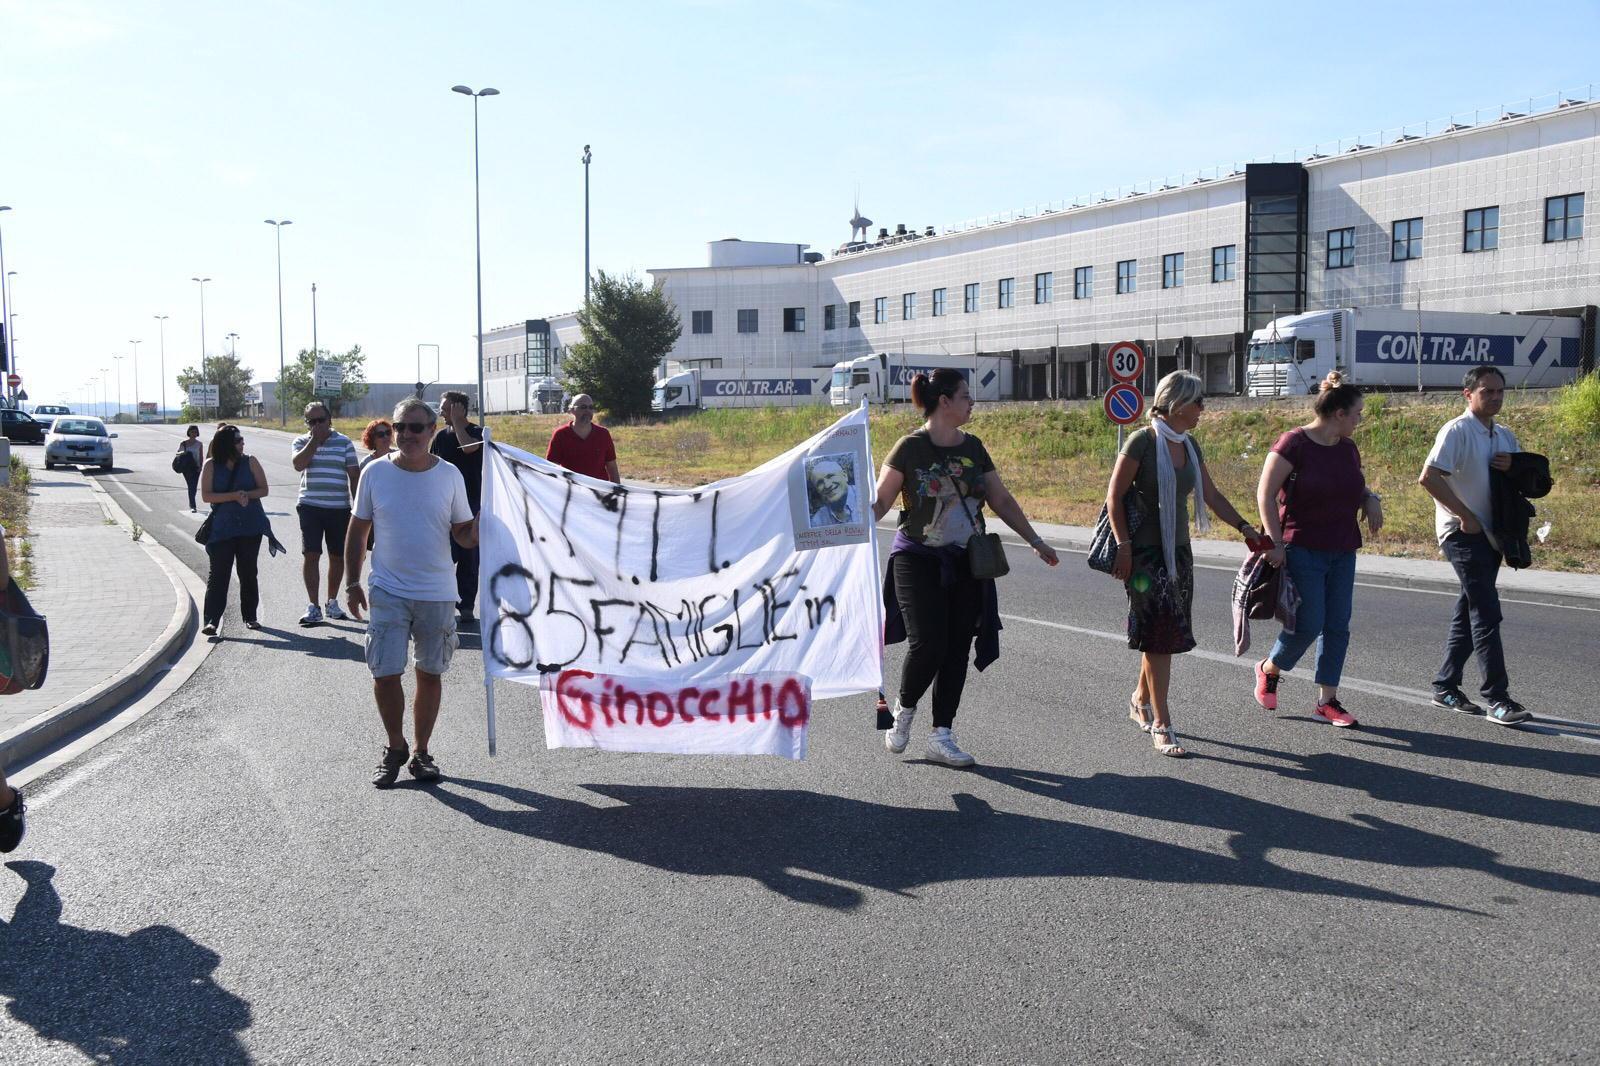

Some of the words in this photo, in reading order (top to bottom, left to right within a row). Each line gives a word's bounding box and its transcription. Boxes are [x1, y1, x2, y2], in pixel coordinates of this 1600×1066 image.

[1376, 334, 1495, 362] CON.TR.AR.
[1116, 353, 1136, 371] 30
[715, 380, 798, 395] CON.TR.AR.
[490, 561, 597, 673] 85
[590, 568, 800, 668] FAMIGLIE
[800, 585, 836, 630] in
